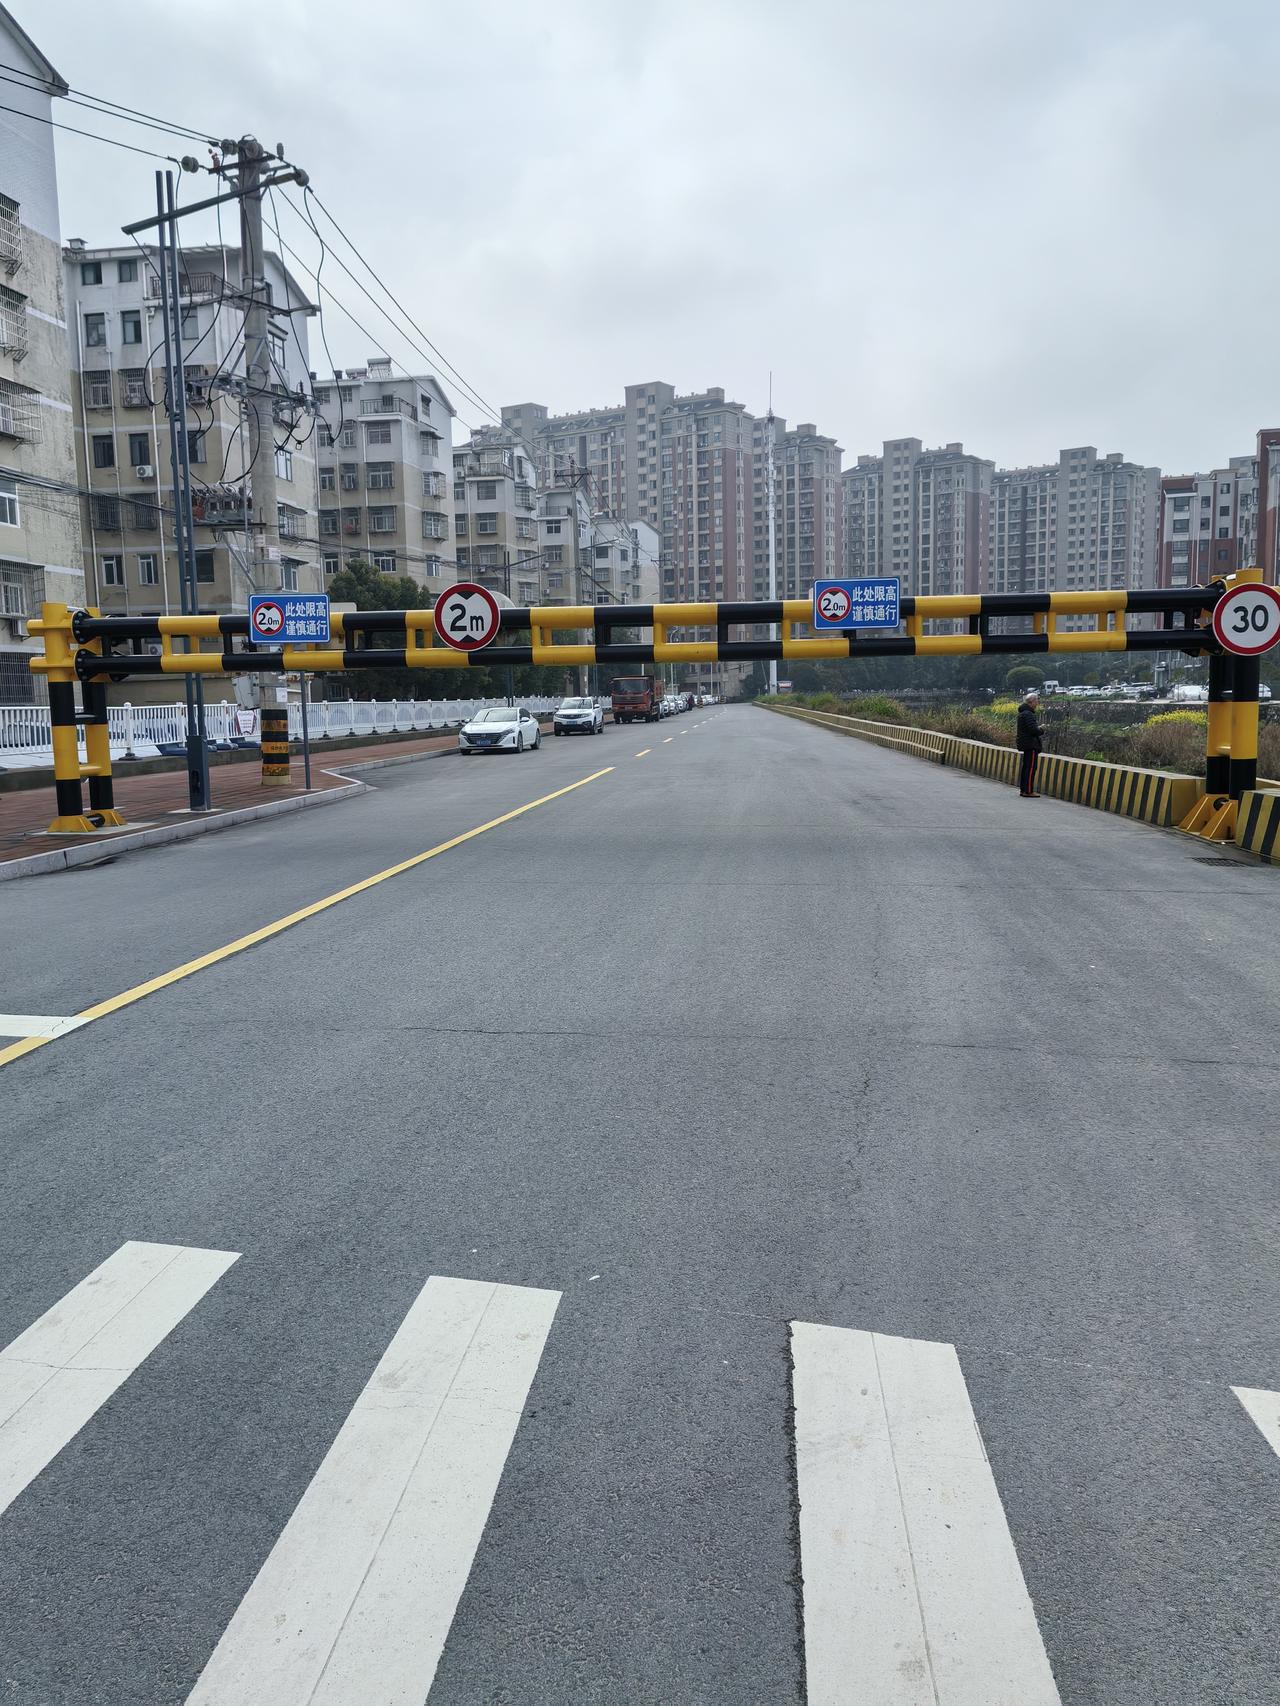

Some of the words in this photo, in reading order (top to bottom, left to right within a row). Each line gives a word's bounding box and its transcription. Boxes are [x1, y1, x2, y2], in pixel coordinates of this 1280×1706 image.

[852, 585, 897, 602] 此处限高
[285, 601, 327, 617] 此处限高
[822, 597, 846, 612] 2.0m
[258, 612, 280, 626] 2.0m
[449, 603, 485, 632] 2m
[852, 605, 897, 622] 谨慎通行
[1231, 604, 1270, 634] 30
[285, 620, 327, 636] 谨慎通行
